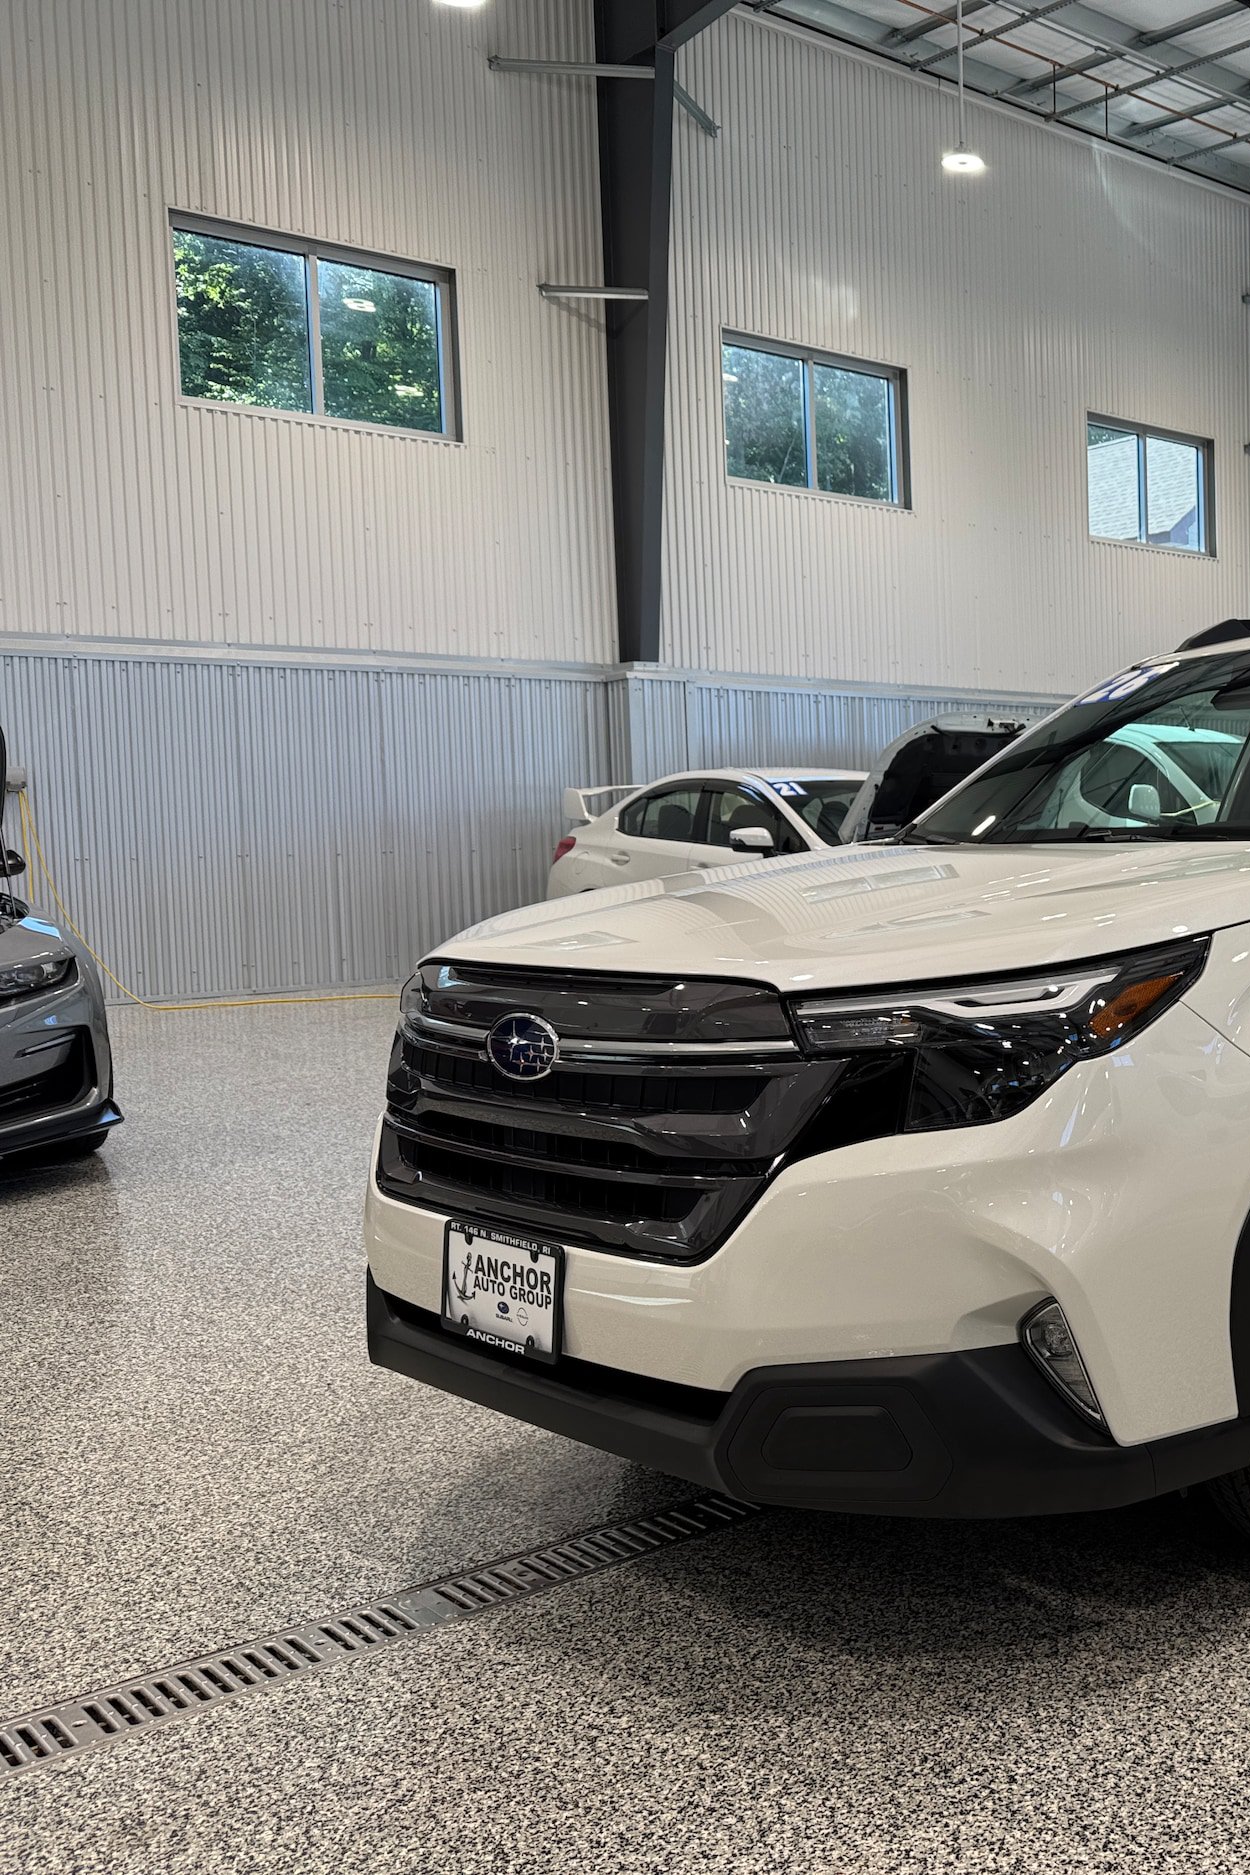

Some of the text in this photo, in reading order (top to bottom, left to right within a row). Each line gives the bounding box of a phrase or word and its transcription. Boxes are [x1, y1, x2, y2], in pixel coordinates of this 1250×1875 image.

[1080, 669, 1149, 703] 26
[772, 781, 808, 796] 21
[450, 1221, 462, 1232] RT.
[463, 1225, 479, 1236] 146
[542, 1245, 551, 1255] RI
[474, 1254, 552, 1295] ANCHOR
[473, 1275, 552, 1310] AUTO GROUP
[466, 1328, 525, 1355] ANCHOR
